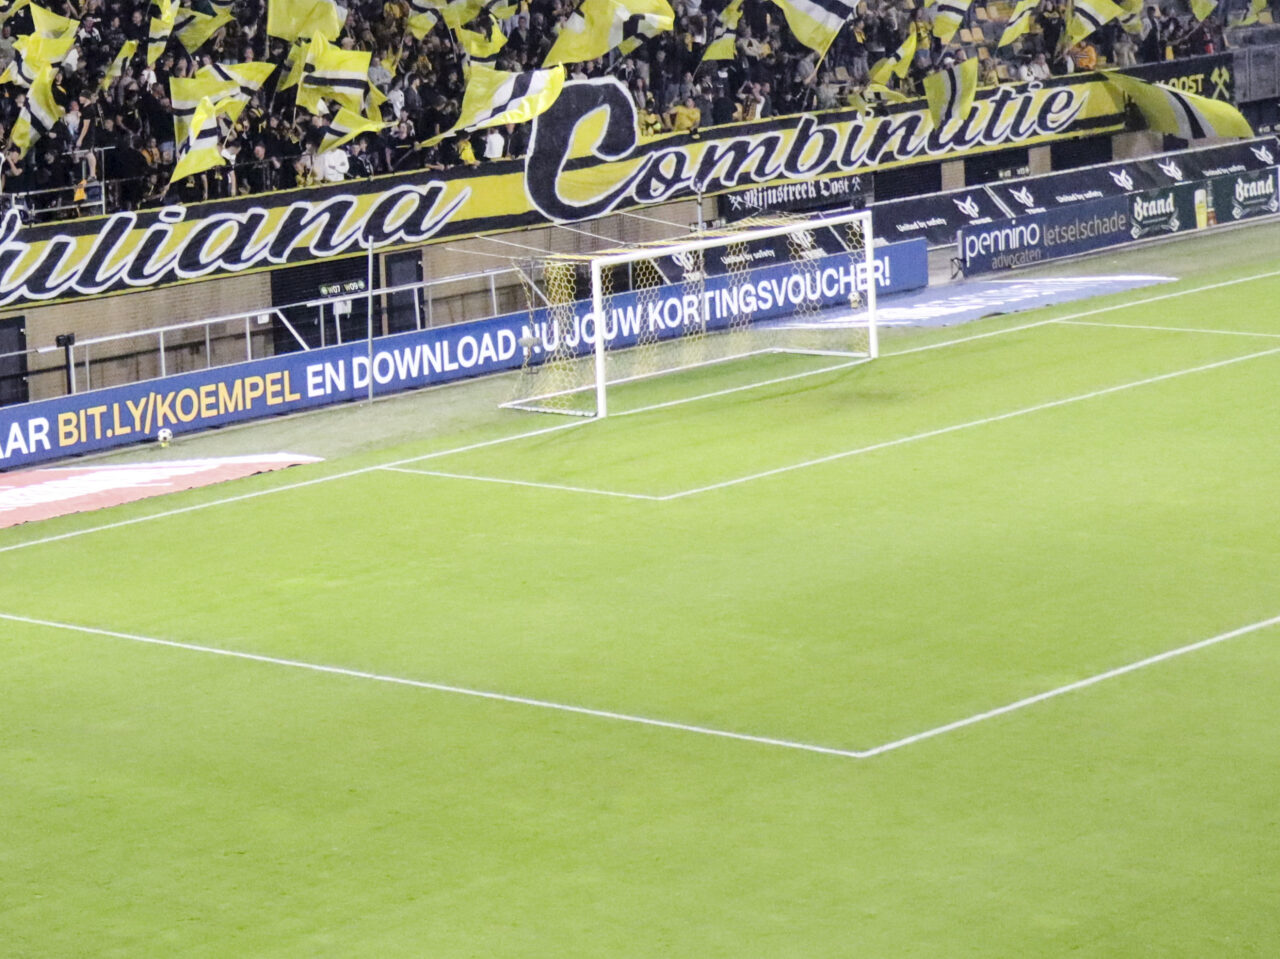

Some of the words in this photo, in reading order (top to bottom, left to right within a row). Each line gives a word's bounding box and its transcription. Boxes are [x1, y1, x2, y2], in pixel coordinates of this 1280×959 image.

[1235, 174, 1274, 202] Brand
[1133, 192, 1175, 222] Brand
[965, 219, 1040, 268] pennino
[1043, 211, 1127, 248] letselschade
[991, 248, 1041, 270] advocaten
[58, 371, 301, 447] BIT.LY/KOEMPEL
[306, 360, 347, 398] EN
[351, 328, 516, 388] DOWNLOAD
[565, 305, 644, 344] JOUW
[648, 255, 891, 332] KORTINGSVOUCHER!
